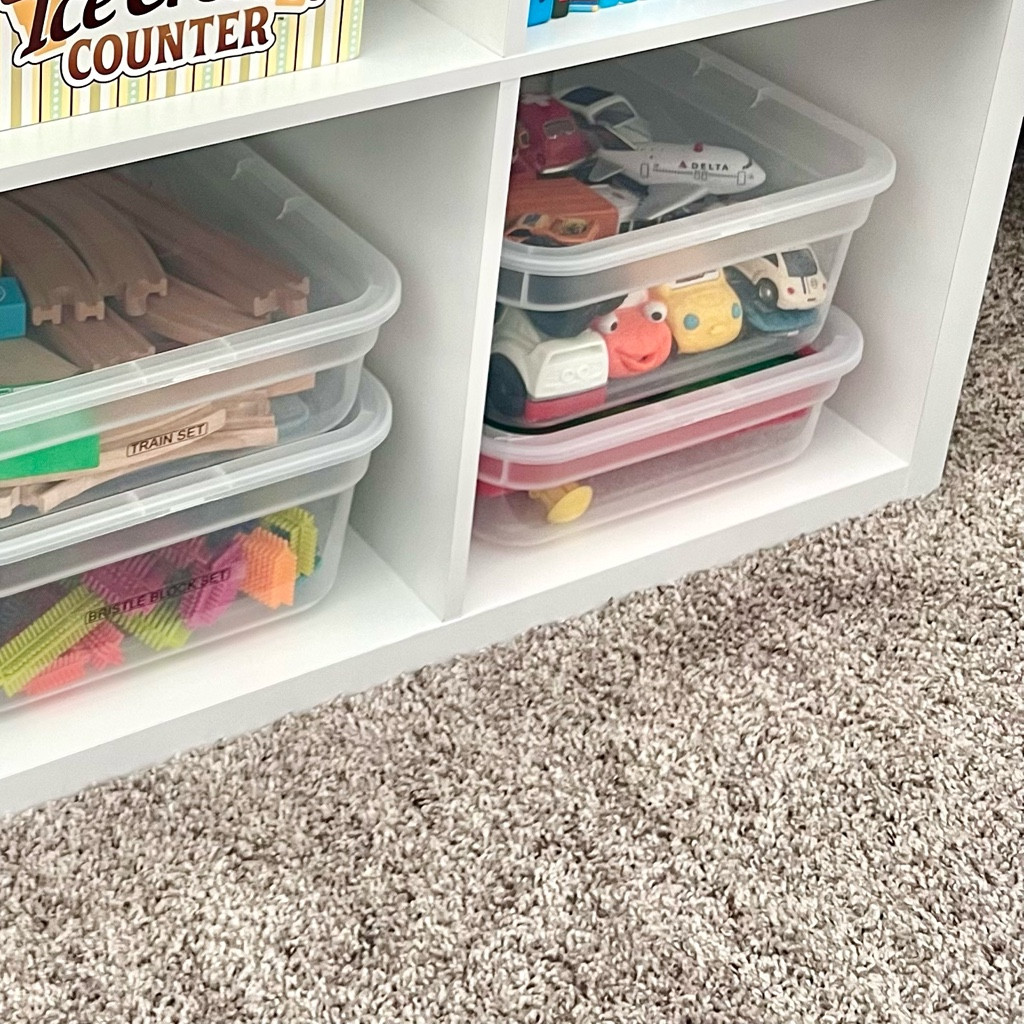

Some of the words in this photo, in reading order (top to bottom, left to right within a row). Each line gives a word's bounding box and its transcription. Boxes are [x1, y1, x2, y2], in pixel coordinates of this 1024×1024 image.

[67, 6, 269, 81] COUNTER
[692, 162, 728, 171] DELTA
[130, 433, 173, 454] TRAIN
[177, 423, 206, 440] SET
[88, 594, 147, 623] BRISTLE
[150, 579, 199, 602] BLOCK
